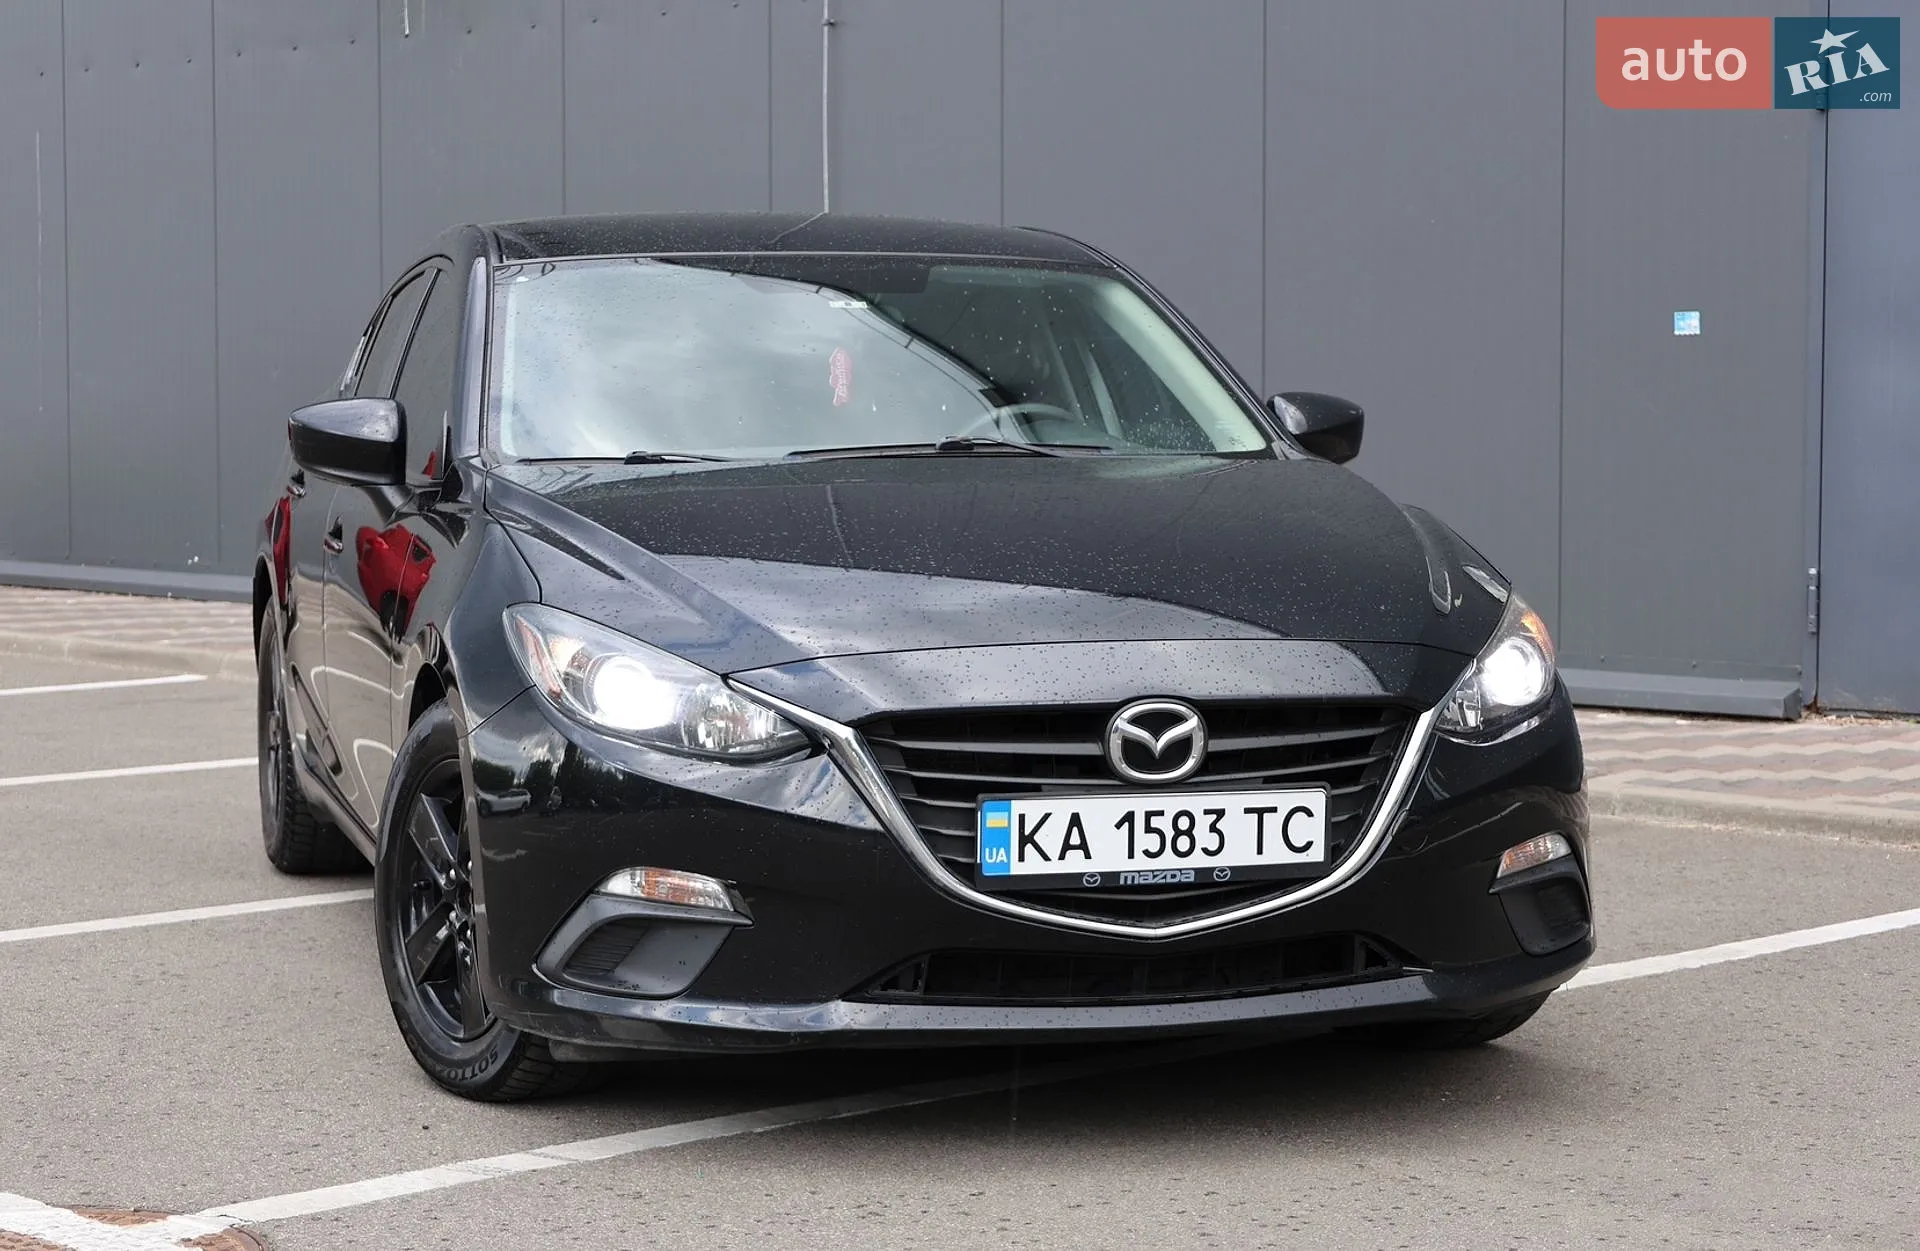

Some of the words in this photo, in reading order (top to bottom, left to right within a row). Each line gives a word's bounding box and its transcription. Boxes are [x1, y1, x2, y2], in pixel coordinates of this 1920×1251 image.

[1017, 812, 1092, 863] KA
[1113, 807, 1226, 860] 1583
[1243, 805, 1315, 856] TC
[985, 847, 1008, 865] UA
